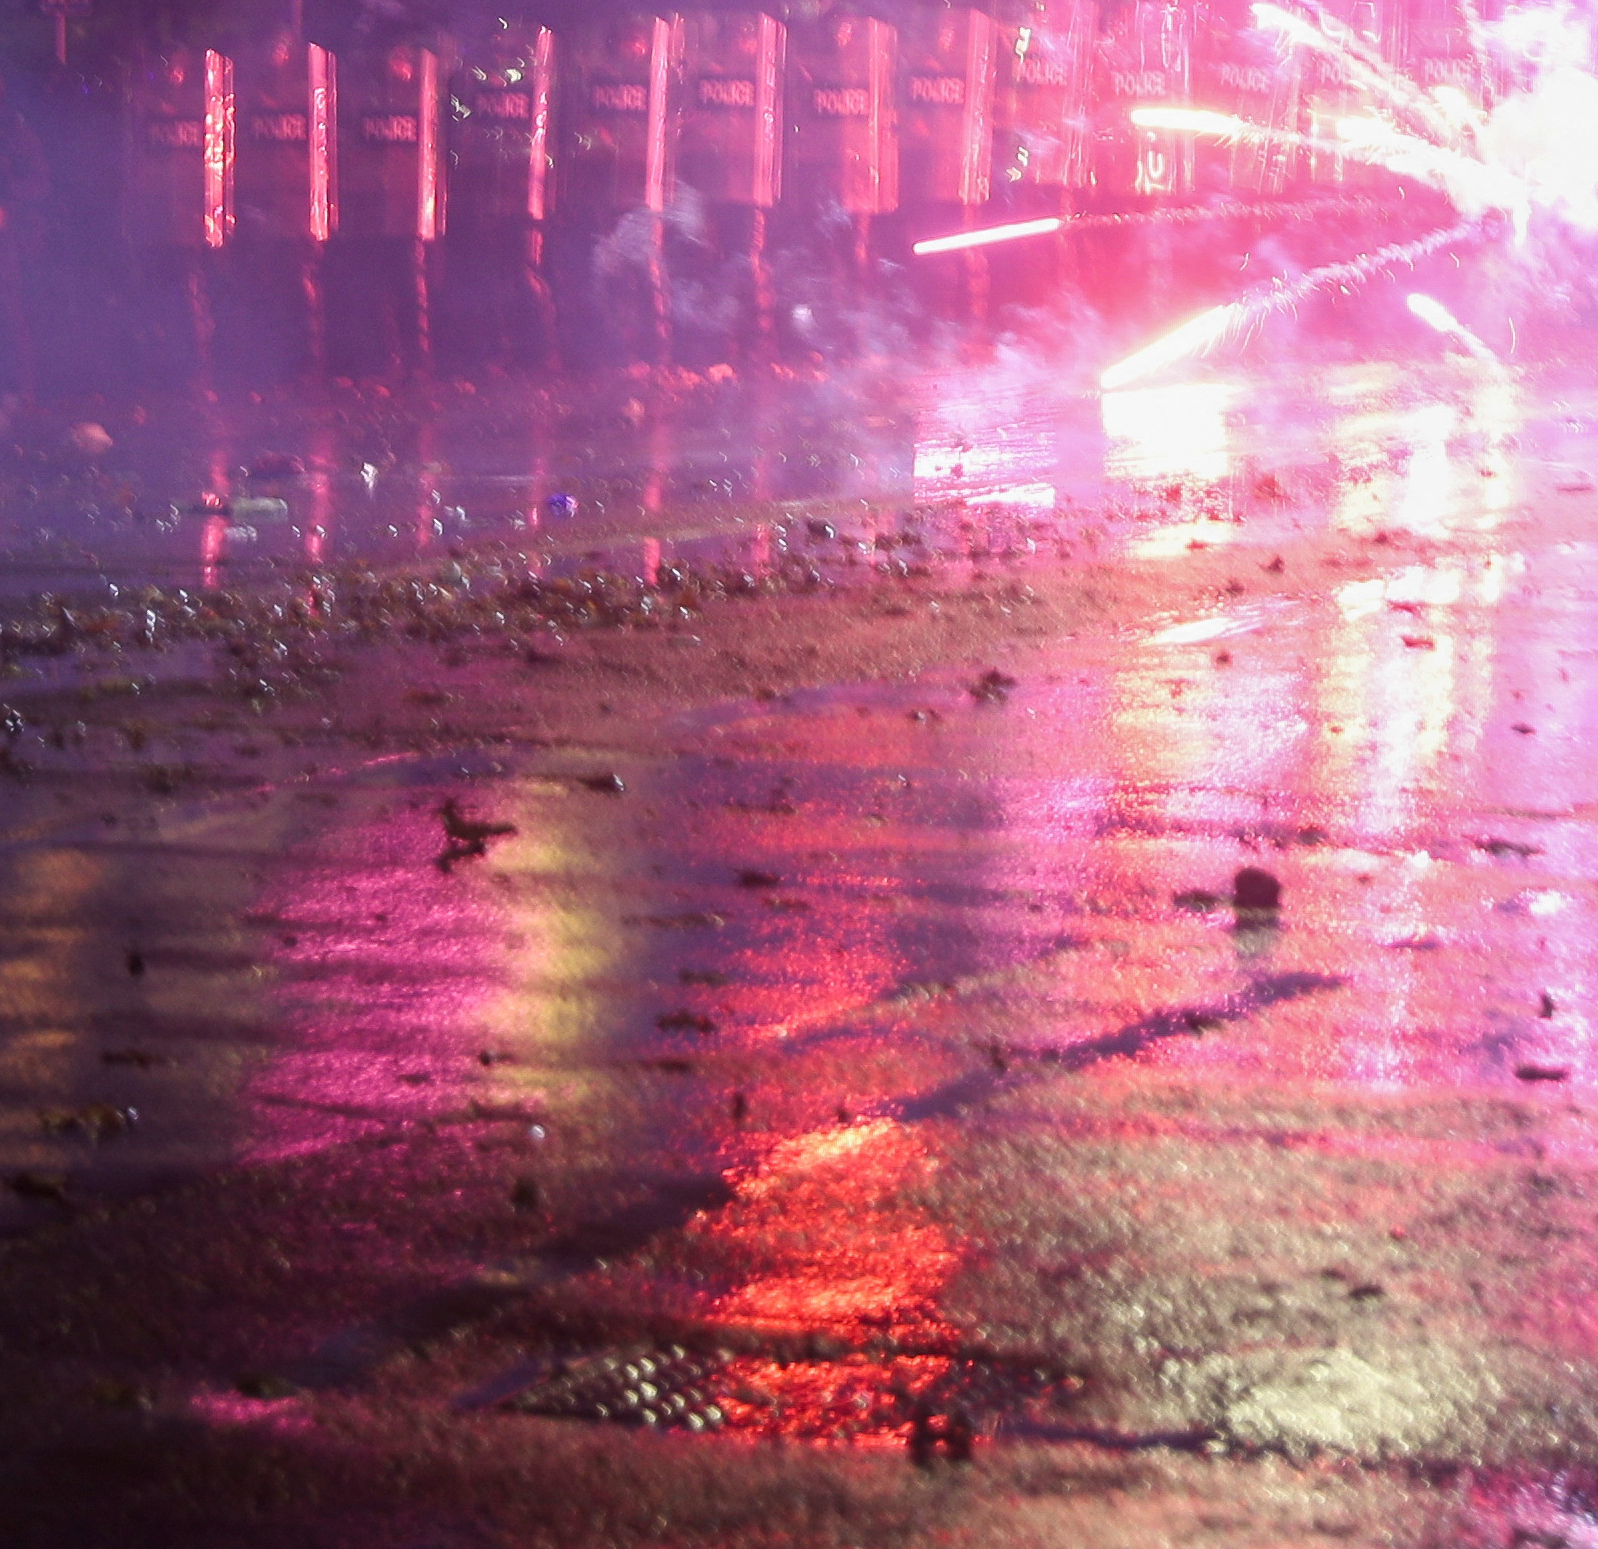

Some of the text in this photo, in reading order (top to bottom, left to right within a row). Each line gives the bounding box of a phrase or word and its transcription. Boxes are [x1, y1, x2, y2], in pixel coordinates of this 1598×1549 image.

[1015, 58, 1067, 86] POLICE
[1113, 71, 1166, 96] POLICE
[1219, 63, 1270, 92] POLICE
[594, 84, 647, 111] POLICE
[700, 79, 755, 108] POLICE
[815, 88, 869, 116] POLICE
[910, 76, 965, 105] POLICE
[476, 93, 529, 119] POLICE
[253, 114, 307, 143] POLICE
[364, 115, 417, 142] POLICE
